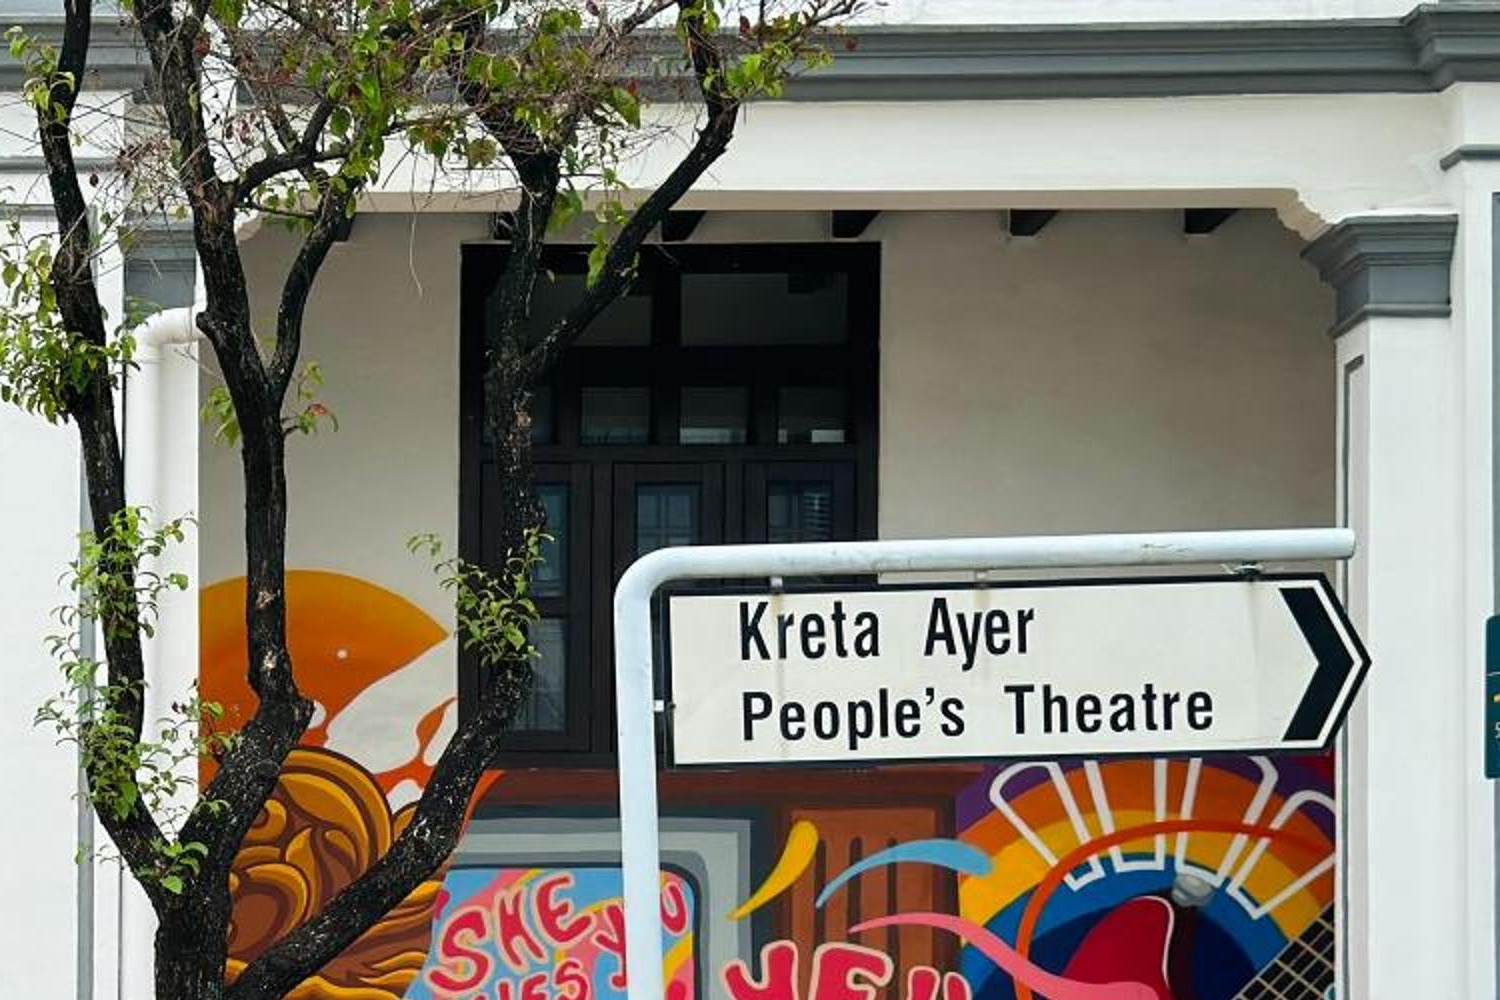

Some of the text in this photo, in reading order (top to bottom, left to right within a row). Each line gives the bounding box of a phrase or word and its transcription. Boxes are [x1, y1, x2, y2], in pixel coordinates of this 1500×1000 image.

[739, 597, 1034, 671] Kreta Ayer
[742, 683, 1213, 750] People's Theatre
